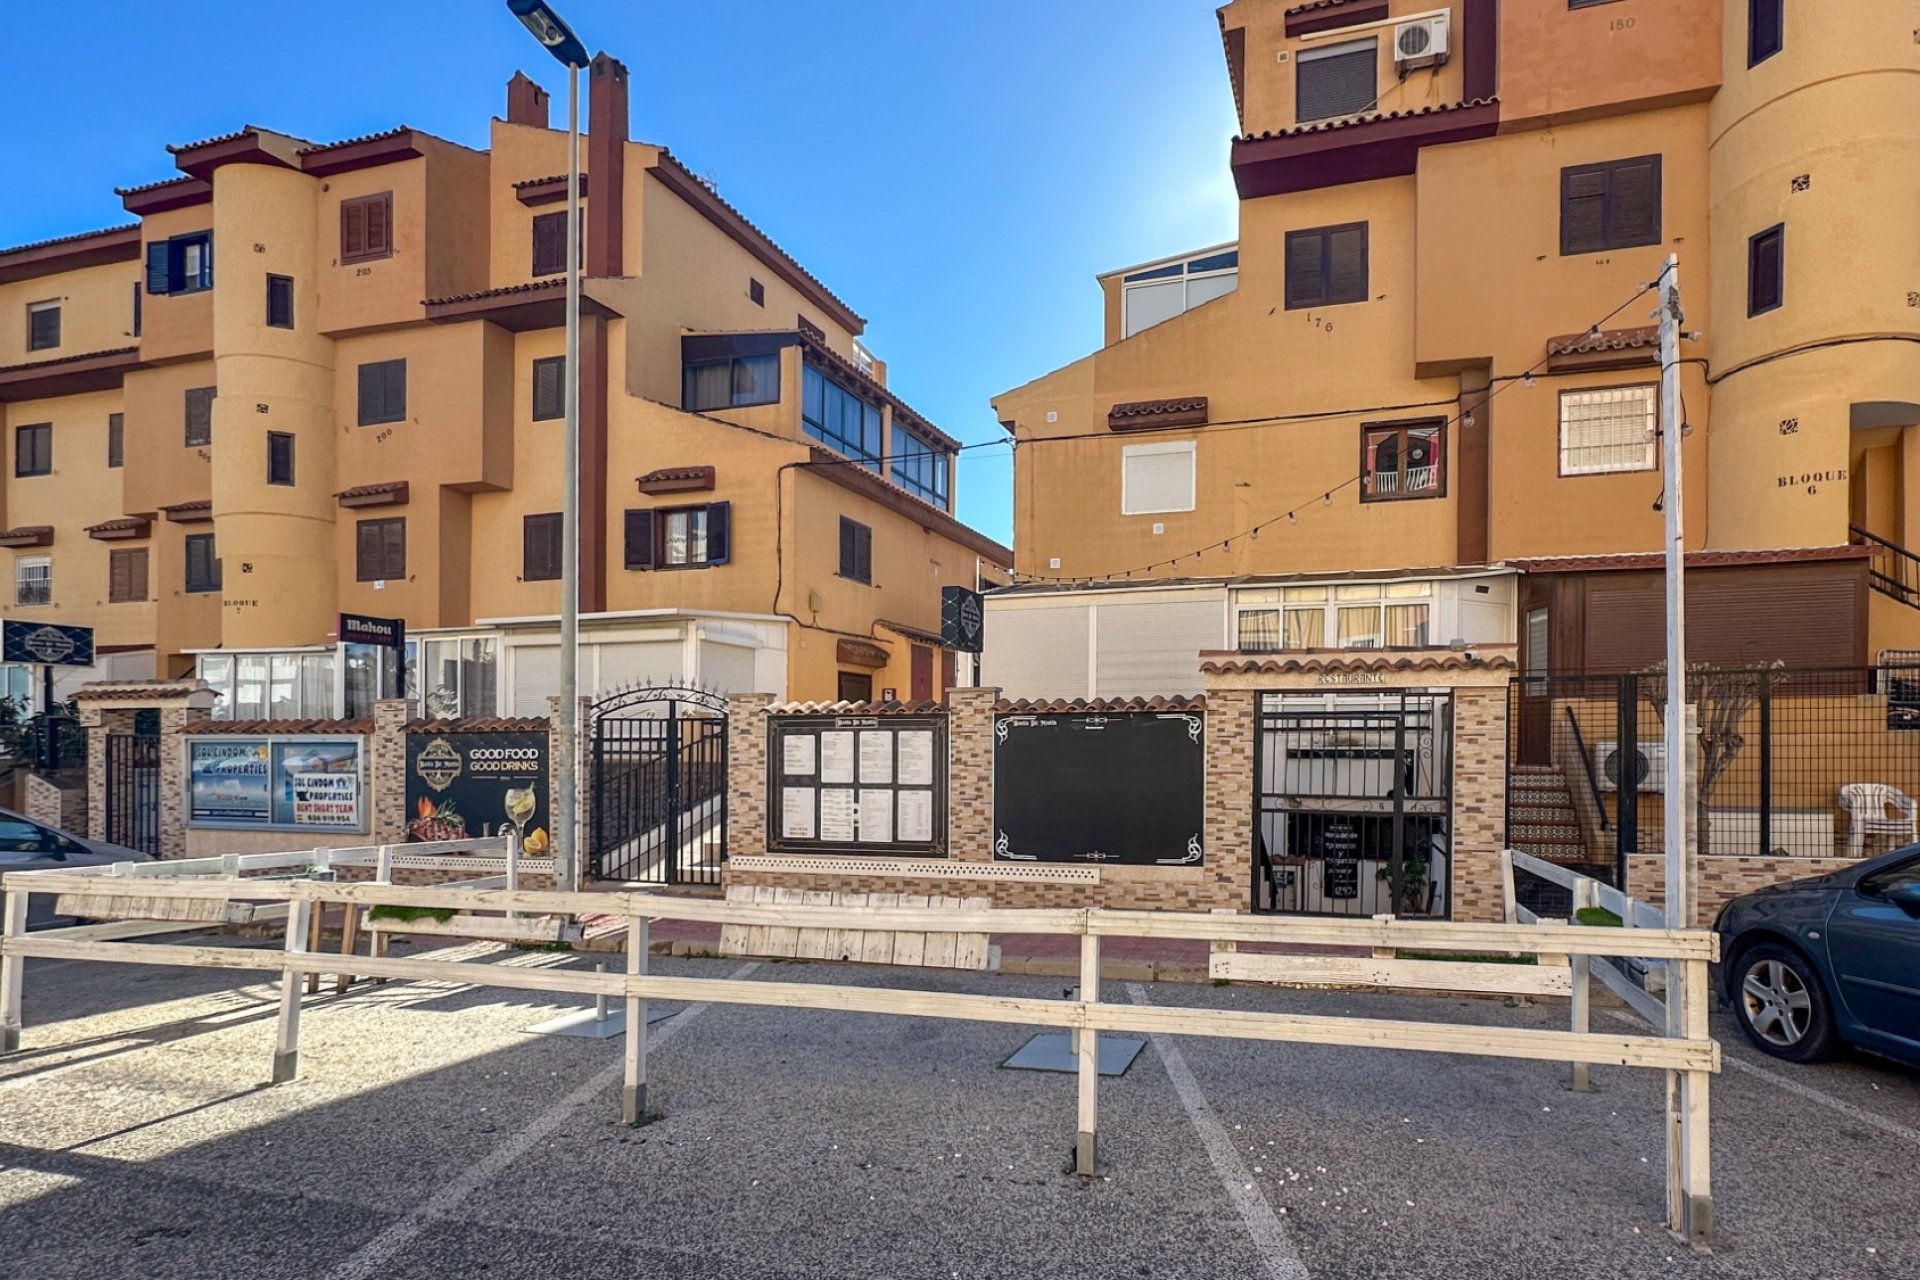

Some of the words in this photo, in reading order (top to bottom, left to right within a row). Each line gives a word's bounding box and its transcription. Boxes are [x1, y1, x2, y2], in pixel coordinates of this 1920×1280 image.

[1610, 16, 1636, 31] 180
[1306, 311, 1334, 333] 176
[375, 428, 393, 444] 200
[1777, 469, 1847, 488] BLOQUE
[1807, 484, 1818, 496] 6
[346, 618, 393, 636] Mahou
[1316, 672, 1386, 684] RESTAURANTE
[469, 748, 504, 760] GOOD
[504, 748, 539, 760] FOOD
[215, 762, 268, 776] PROPERTIES
[469, 761, 501, 772] GOOD
[500, 761, 539, 772] DRINKS
[309, 791, 354, 802] PROPERTIES
[296, 803, 313, 813] RENT
[313, 803, 334, 814] SHORT
